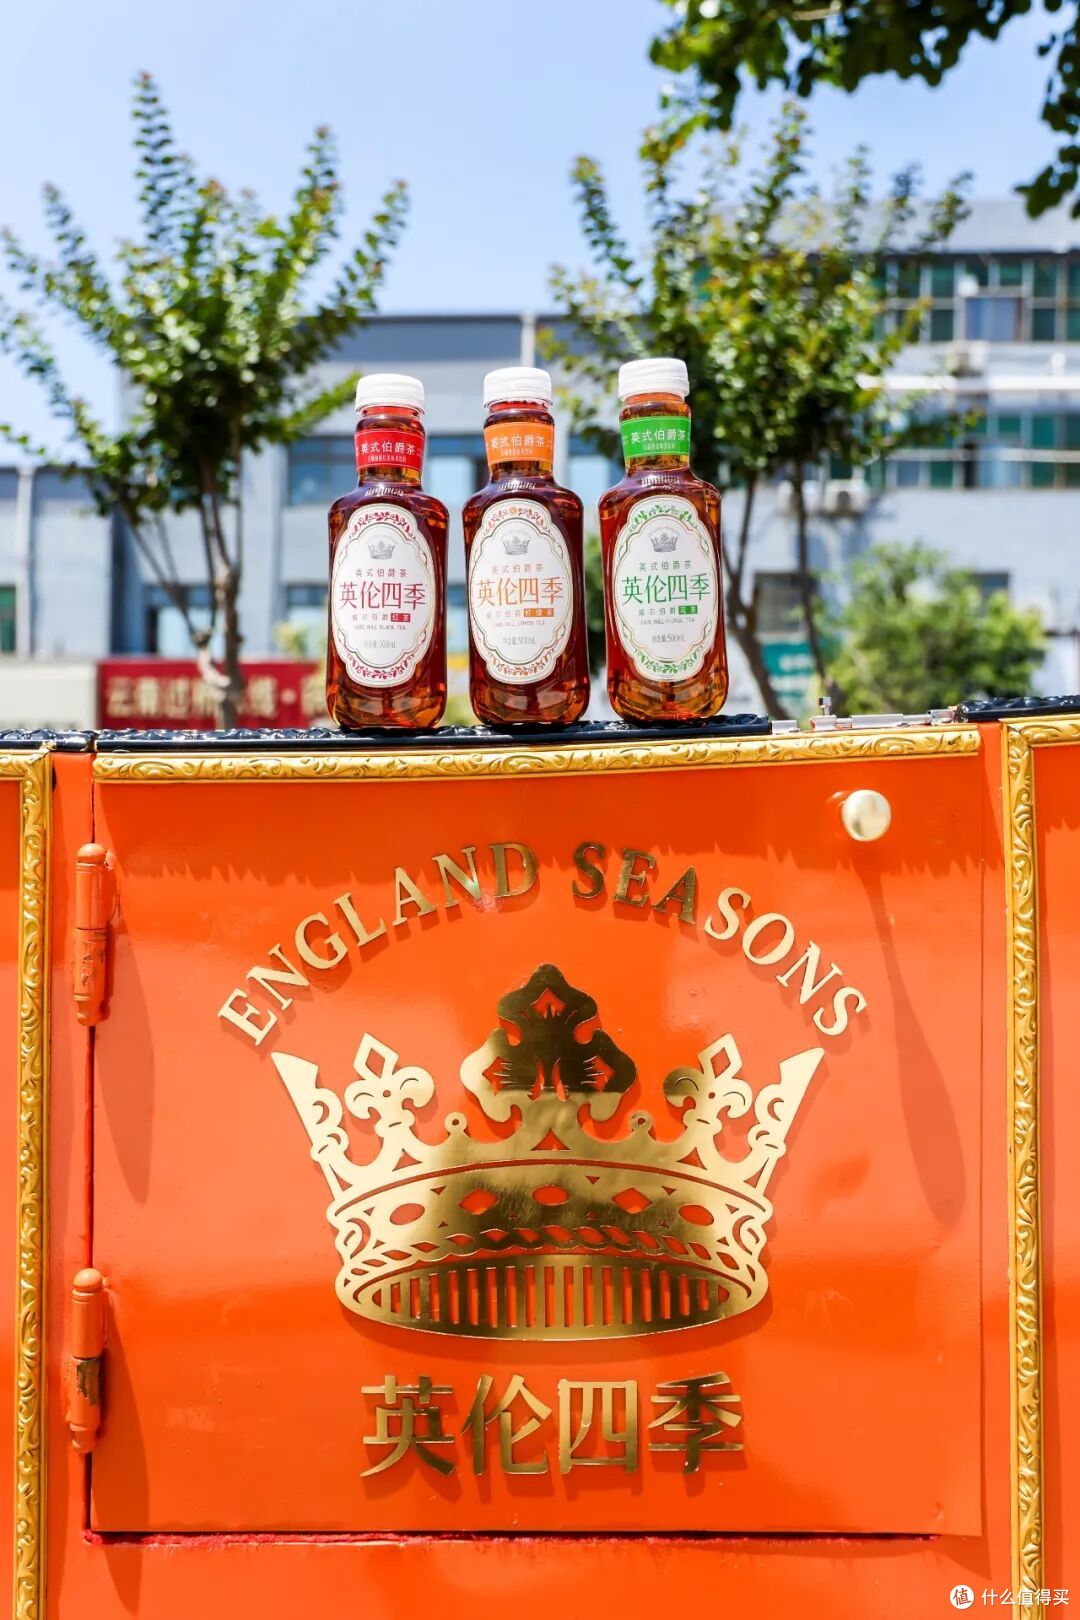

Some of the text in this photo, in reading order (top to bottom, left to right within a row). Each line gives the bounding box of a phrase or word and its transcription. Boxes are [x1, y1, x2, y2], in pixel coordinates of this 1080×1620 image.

[491, 434, 544, 448] 英式伯爵茶
[631, 429, 686, 444] 英式伯爵茶
[361, 441, 416, 455] 英式伯爵茶
[355, 568, 407, 578] 英式伯爵茶
[491, 563, 543, 574] 英式伯爵茶
[639, 560, 692, 571] 英式伯爵茶
[339, 581, 427, 610] 英伦四季
[477, 576, 564, 607] 英伦四季
[622, 573, 711, 605] 英伦四季
[217, 842, 868, 1046] ENGLAND SEASONS
[359, 1372, 744, 1476] 英伦四季
